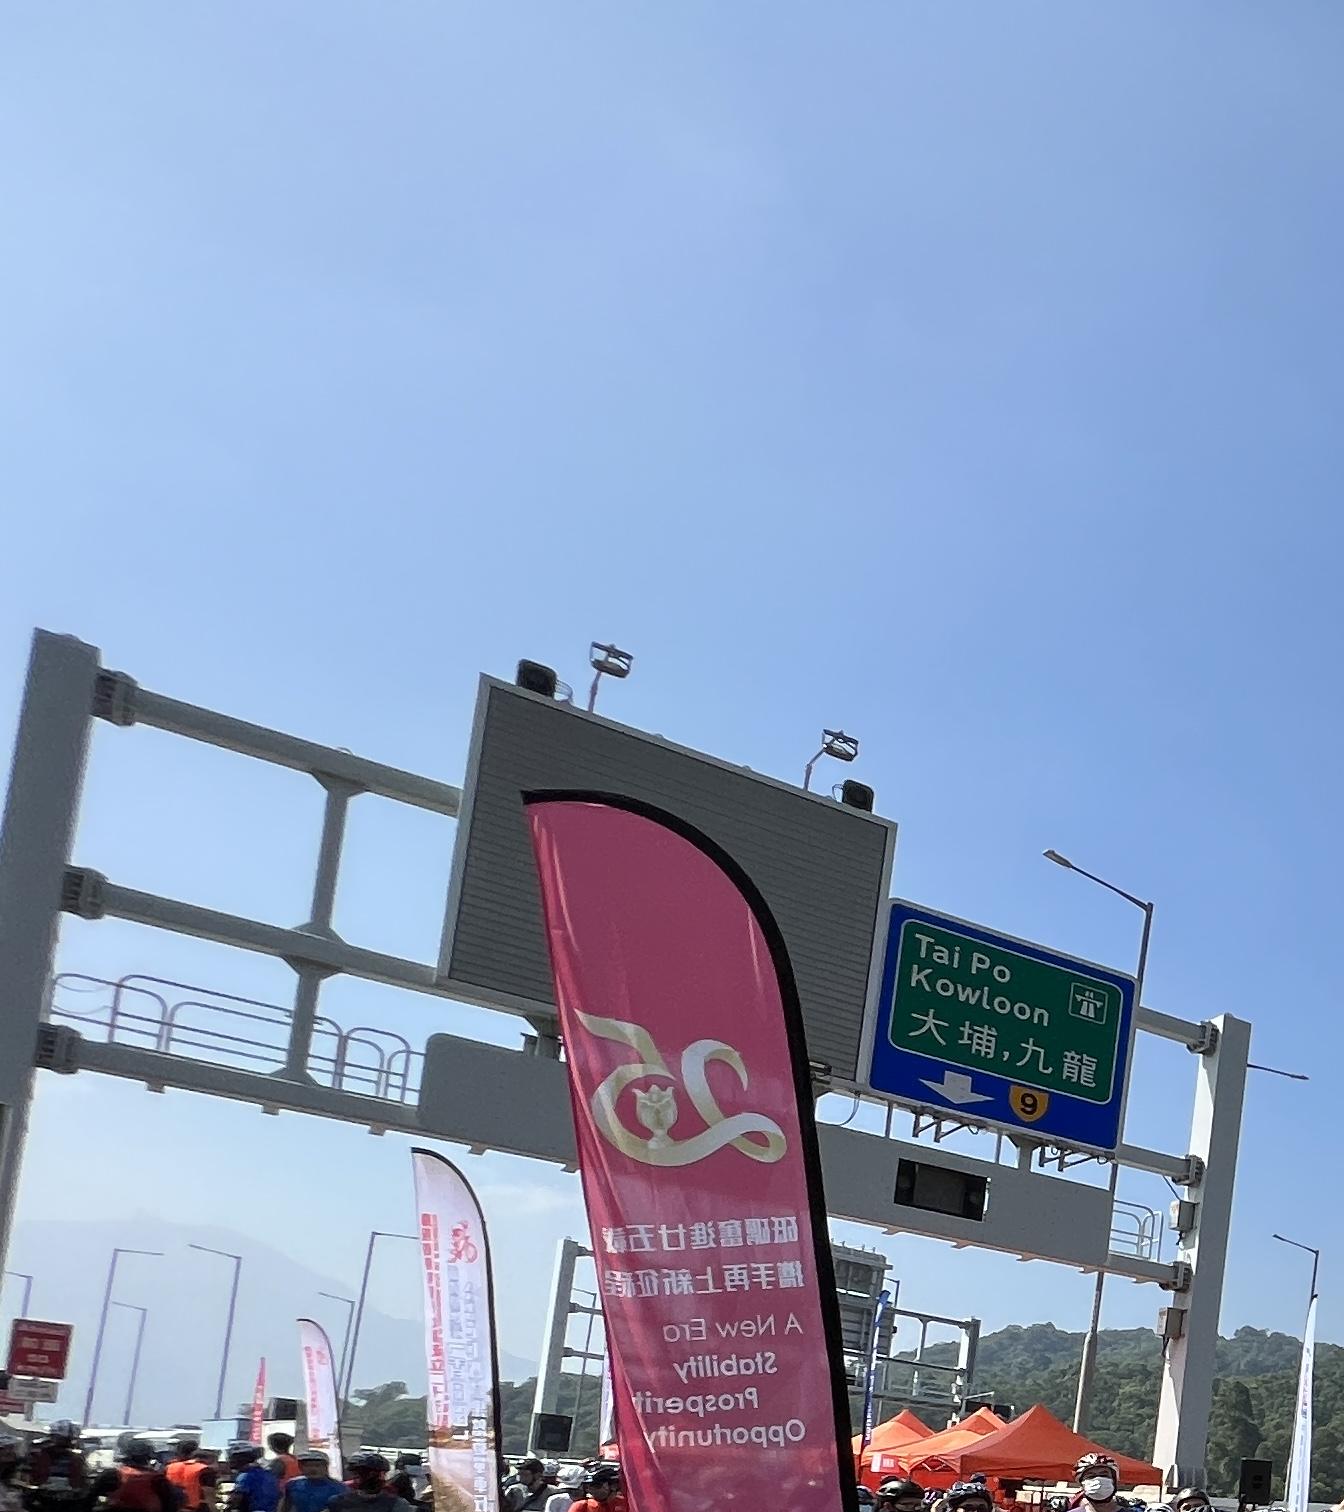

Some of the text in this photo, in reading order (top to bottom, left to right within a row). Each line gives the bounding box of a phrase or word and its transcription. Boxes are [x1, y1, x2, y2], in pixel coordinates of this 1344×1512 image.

[914, 932, 1011, 983] Tai Po
[910, 963, 1050, 1027] Kowloon
[1019, 1092, 1039, 1117] 9
